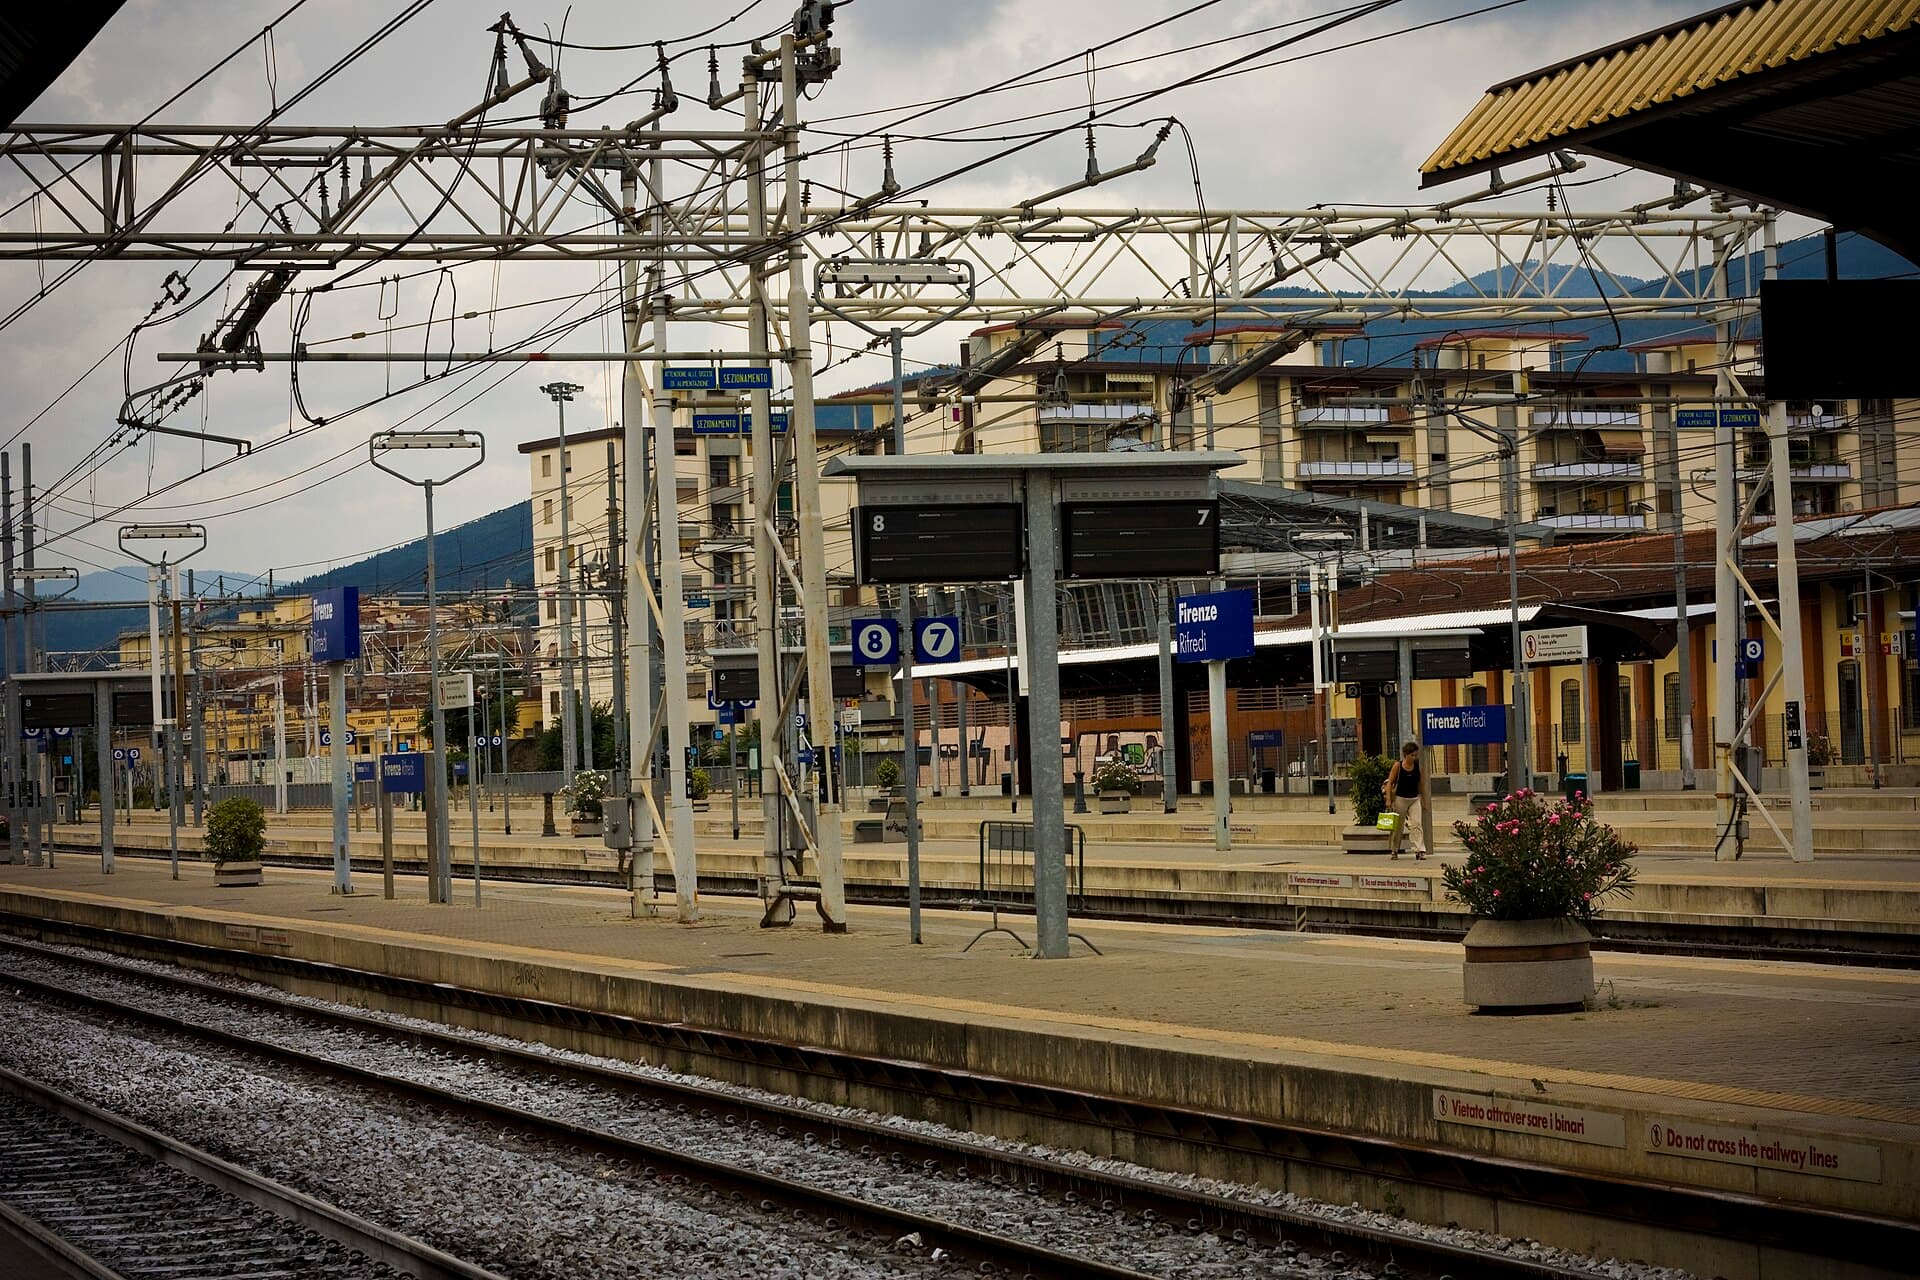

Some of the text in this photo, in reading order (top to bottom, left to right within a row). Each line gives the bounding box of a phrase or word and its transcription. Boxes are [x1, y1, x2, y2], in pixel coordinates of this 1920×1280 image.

[723, 373, 768, 383] SEZIONAMENTO
[696, 419, 737, 429] SEZIONAMENTO
[872, 514, 885, 532] 8
[1197, 508, 1211, 526] 7
[1178, 602, 1218, 624] Firenze
[867, 630, 883, 653] 8
[929, 628, 947, 651] 7
[1179, 629, 1207, 654] Rifredi
[1464, 651, 1470, 659] 3
[1750, 644, 1757, 654] 3
[720, 673, 726, 681] 6
[855, 669, 862, 677] 5
[796, 717, 802, 726] 3
[1426, 711, 1487, 730] Firenze Rifredi
[324, 734, 331, 743] 6
[384, 759, 401, 776] Firenze
[1451, 1099, 1485, 1120] Vietato
[1555, 1113, 1585, 1135] binari
[1667, 1128, 1838, 1169] Do not cross the railway lines
